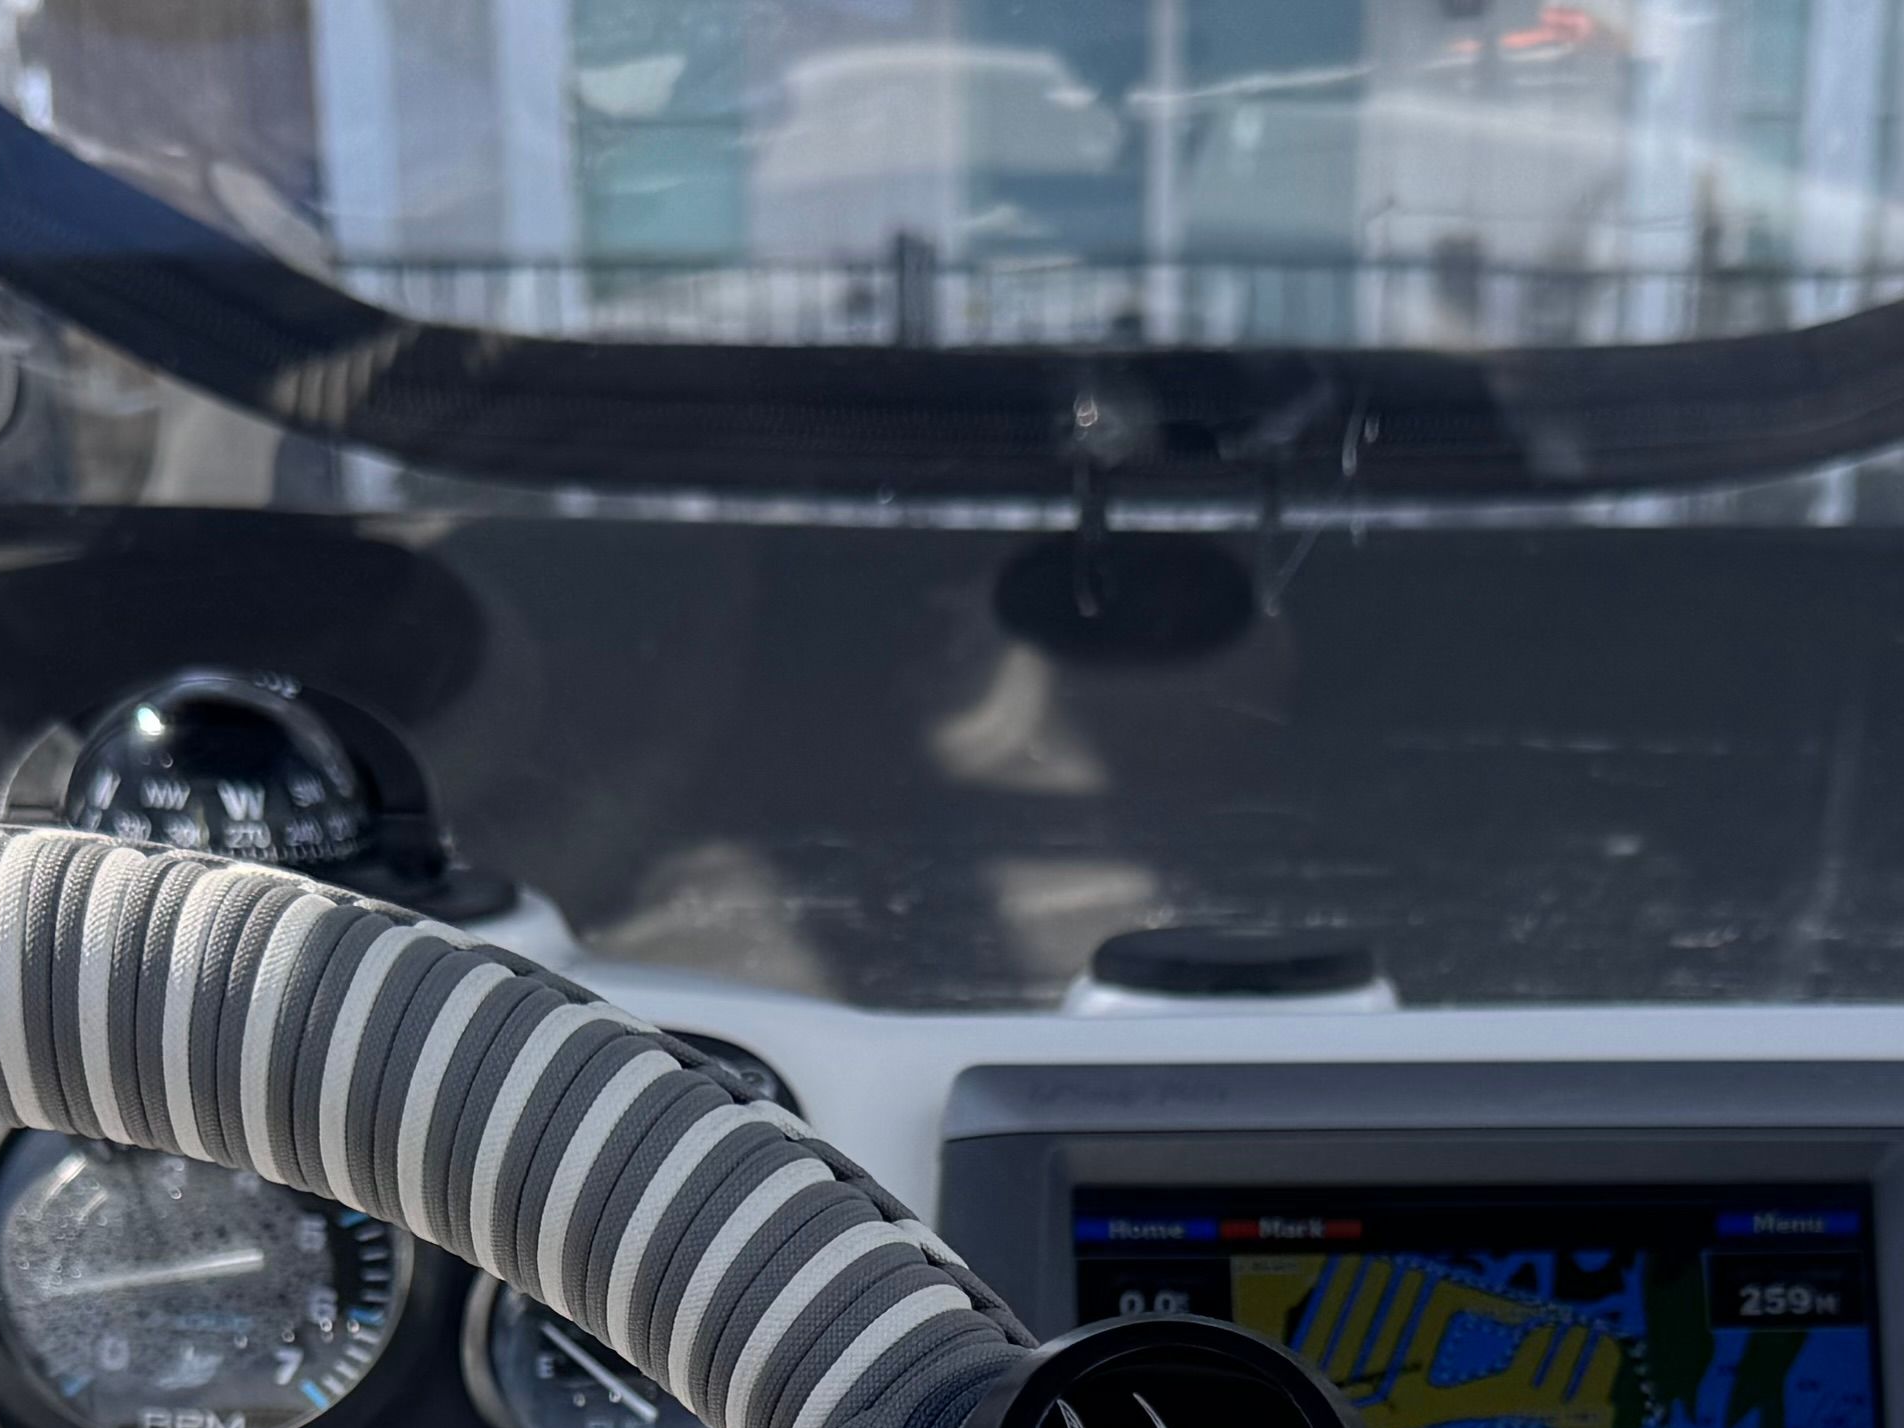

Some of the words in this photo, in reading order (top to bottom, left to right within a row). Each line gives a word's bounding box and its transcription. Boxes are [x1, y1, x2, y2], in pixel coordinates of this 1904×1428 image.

[1109, 1217, 1184, 1239] Home
[1259, 1217, 1326, 1238] Mark
[1753, 1210, 1825, 1234] Menu
